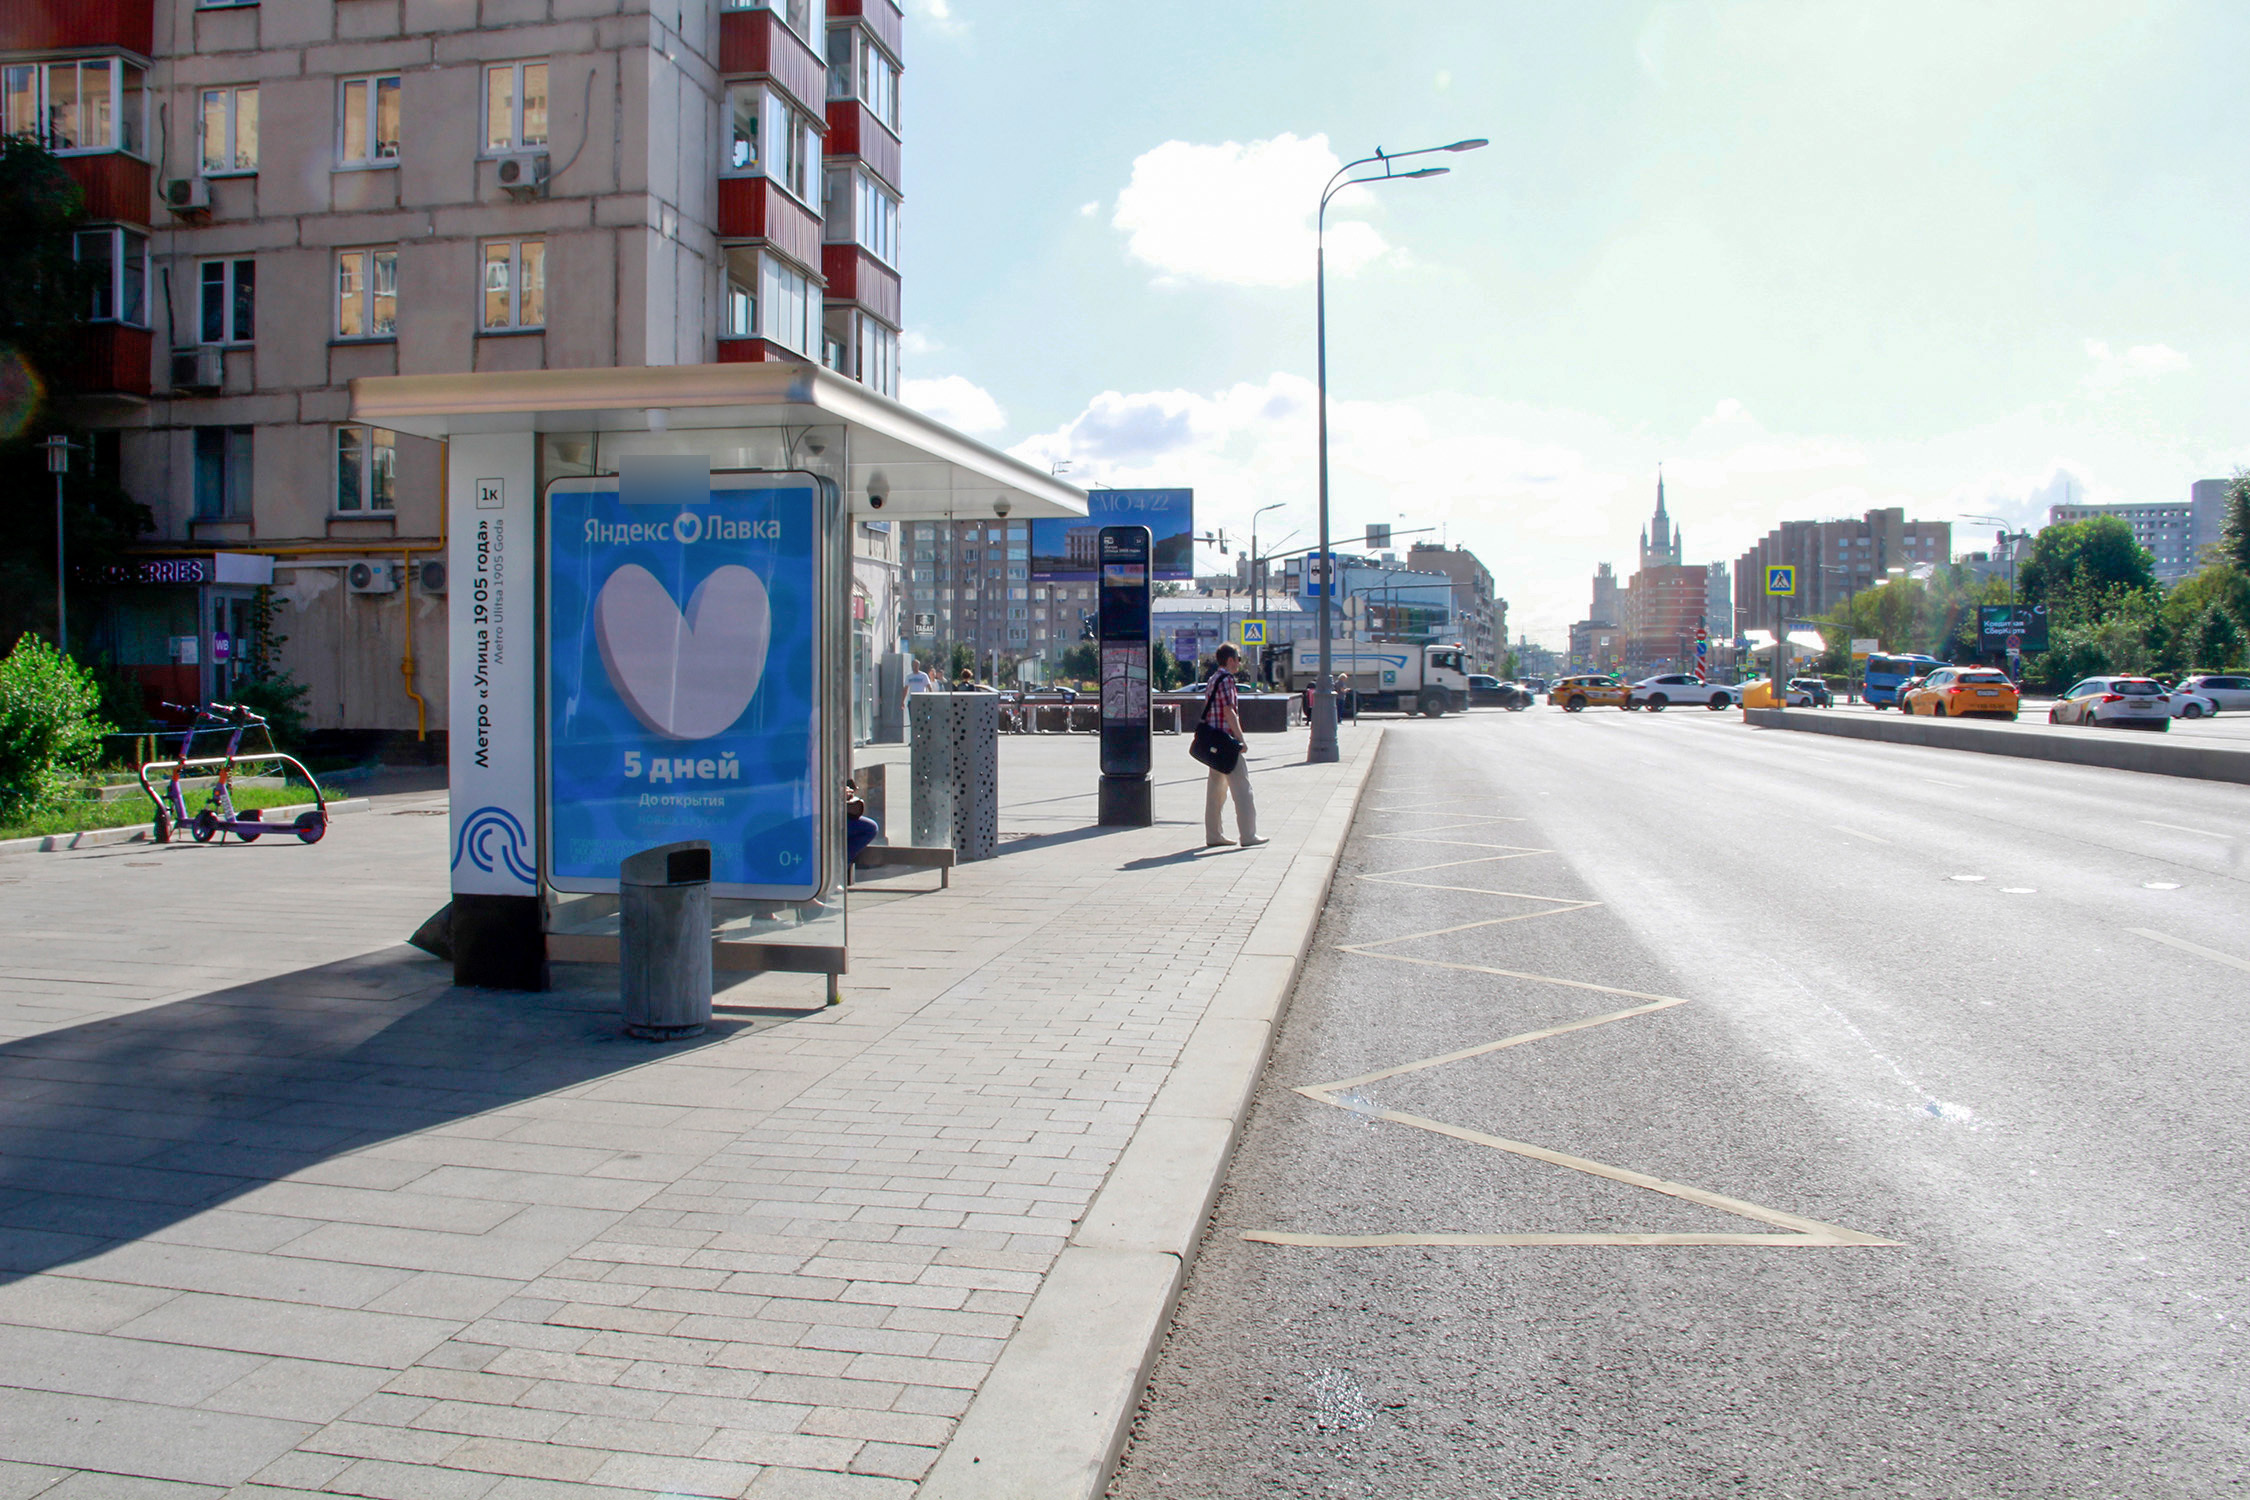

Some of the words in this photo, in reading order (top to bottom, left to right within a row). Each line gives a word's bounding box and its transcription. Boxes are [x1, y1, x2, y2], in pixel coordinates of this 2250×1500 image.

[477, 520, 490, 572] года»
[494, 519, 504, 552] Goda
[584, 518, 670, 545] Яндекс
[704, 514, 781, 540] Лавка
[494, 555, 503, 586] 1905
[474, 578, 488, 624] 1905
[494, 590, 503, 623] Ulitsa
[915, 624, 934, 632] ТАБАК
[215, 639, 229, 651] WB
[494, 626, 503, 665] Metro
[474, 629, 490, 698] «Улица
[474, 704, 491, 768] Метро
[624, 751, 642, 778] 5
[649, 751, 740, 784] дней
[639, 793, 659, 808] До
[661, 796, 725, 808] открытия
[779, 850, 803, 866] 0+
